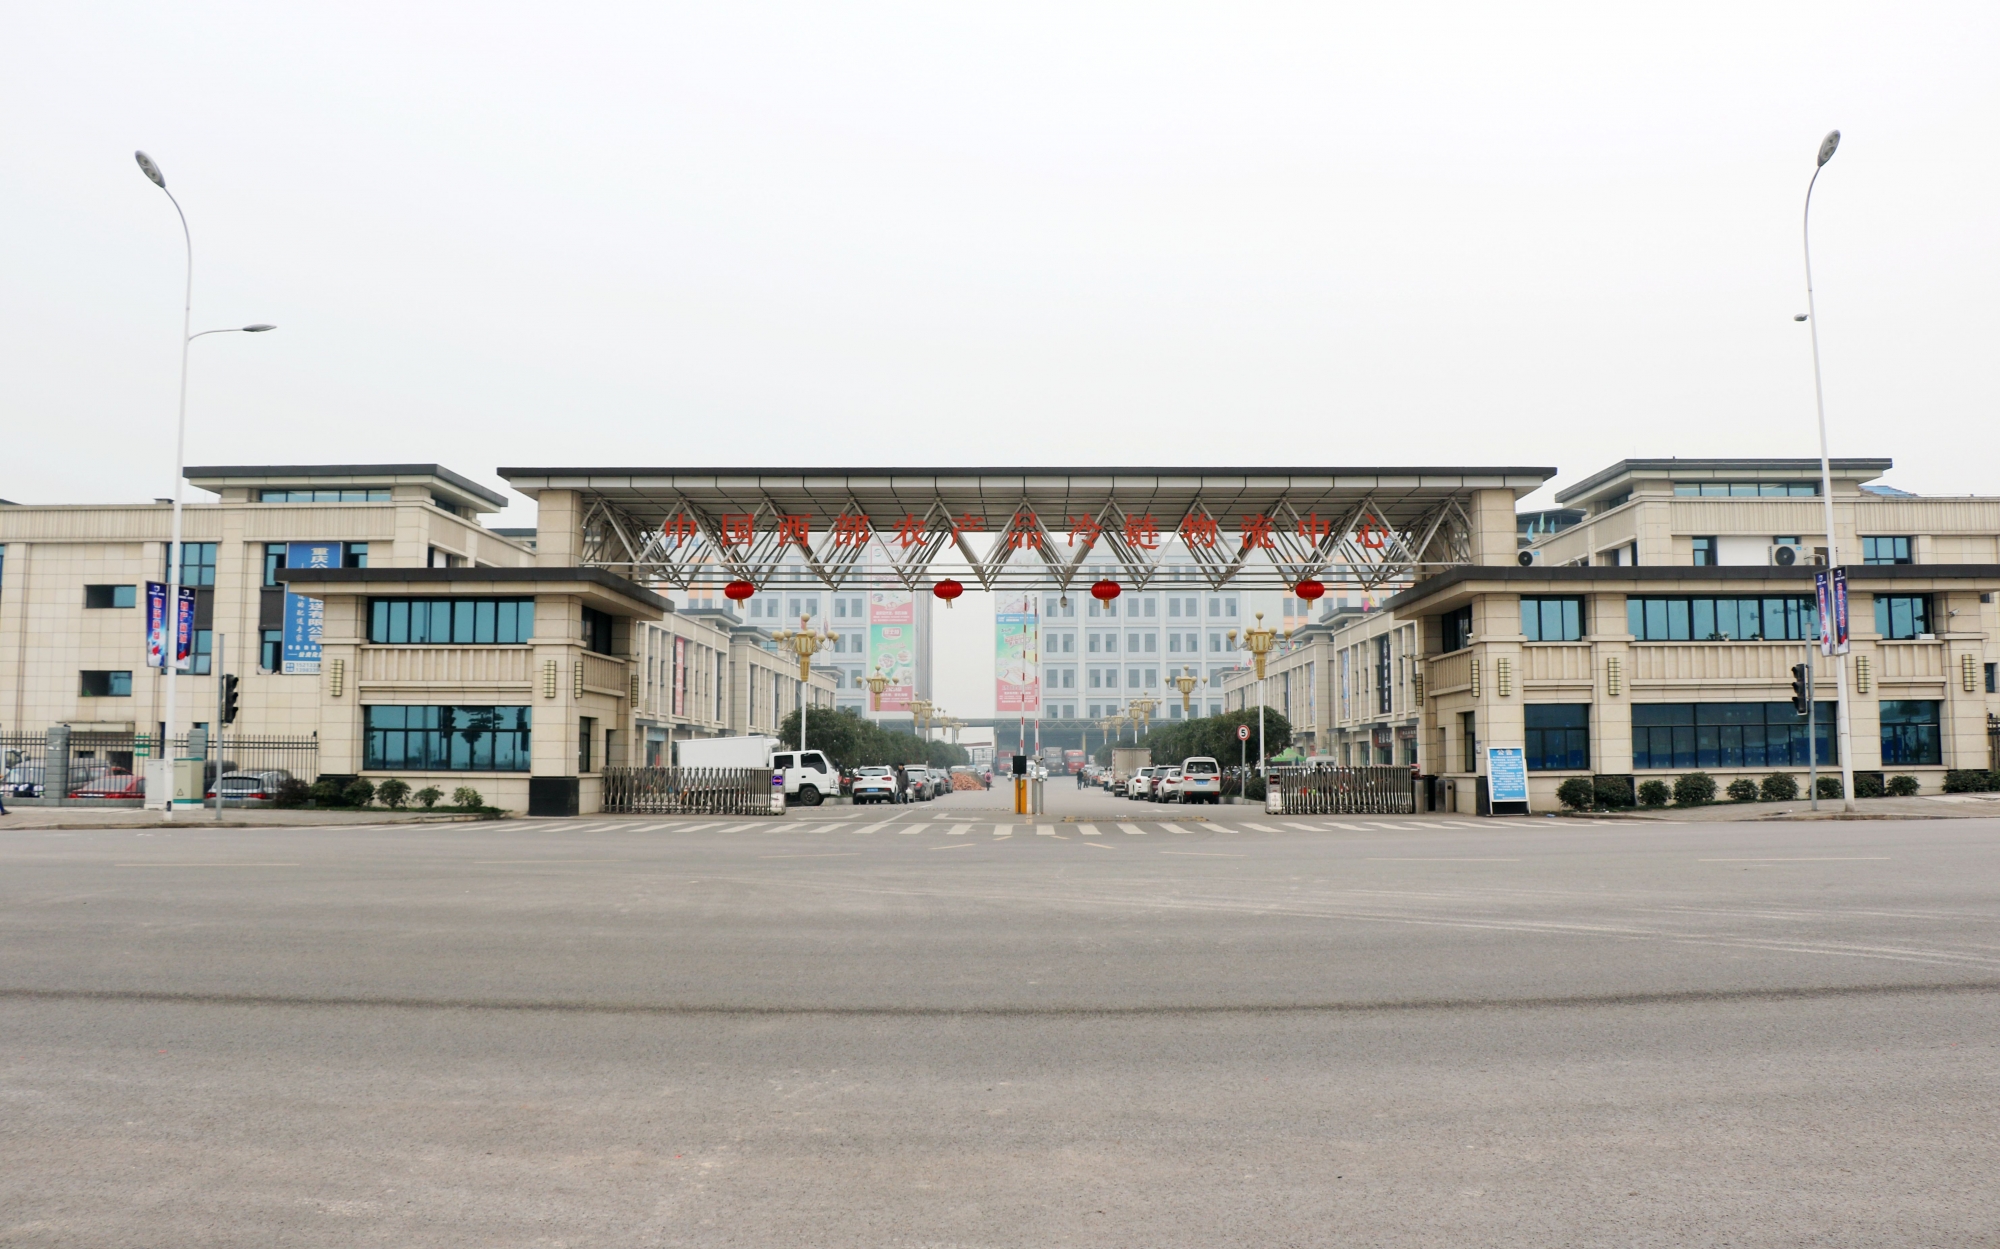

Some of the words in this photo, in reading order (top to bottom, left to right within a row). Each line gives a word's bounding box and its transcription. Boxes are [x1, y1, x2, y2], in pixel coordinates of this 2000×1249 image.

[665, 512, 1389, 549] 中国西部农产品冷链物流中心
